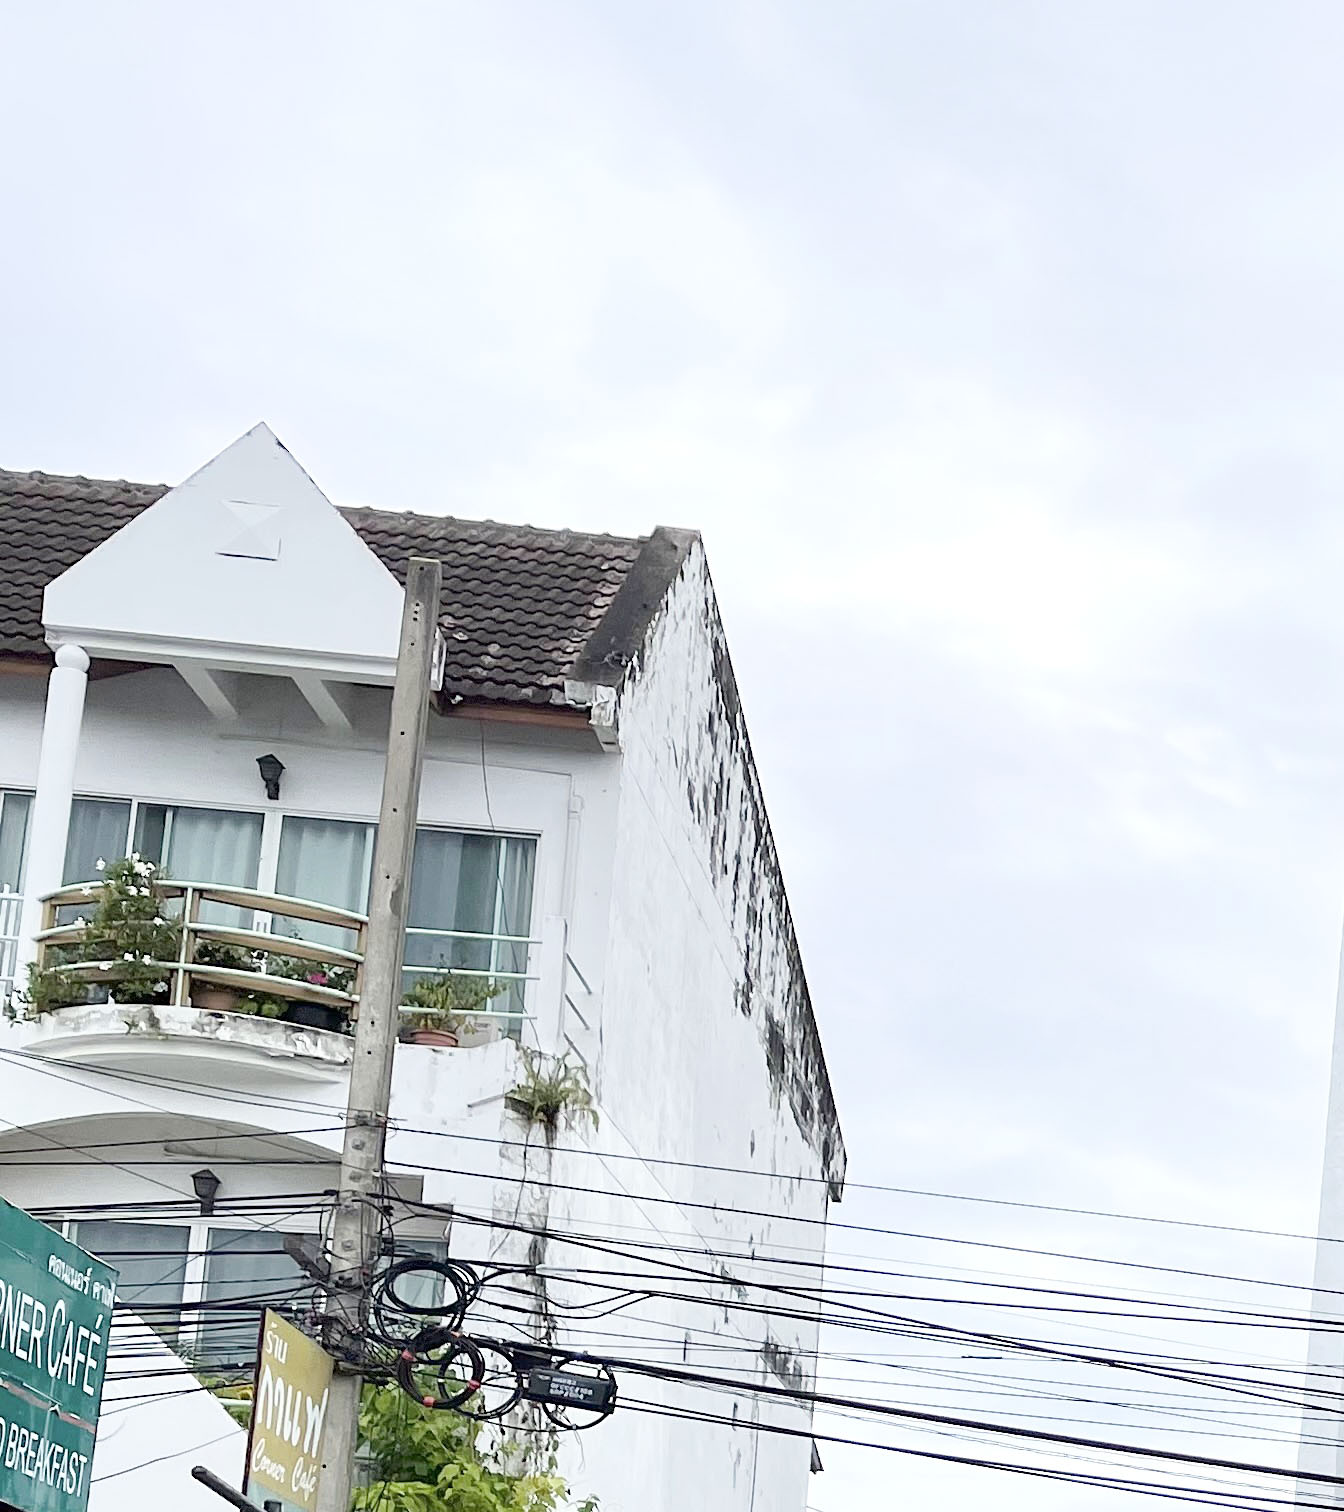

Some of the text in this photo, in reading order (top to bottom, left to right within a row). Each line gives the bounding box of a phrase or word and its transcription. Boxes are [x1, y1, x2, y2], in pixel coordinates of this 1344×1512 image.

[0, 1279, 103, 1397] NER CAFÉ
[265, 1321, 288, 1364] ร้าน
[256, 1364, 329, 1458] กาแฟ
[5, 1422, 87, 1497] BREAKFAST
